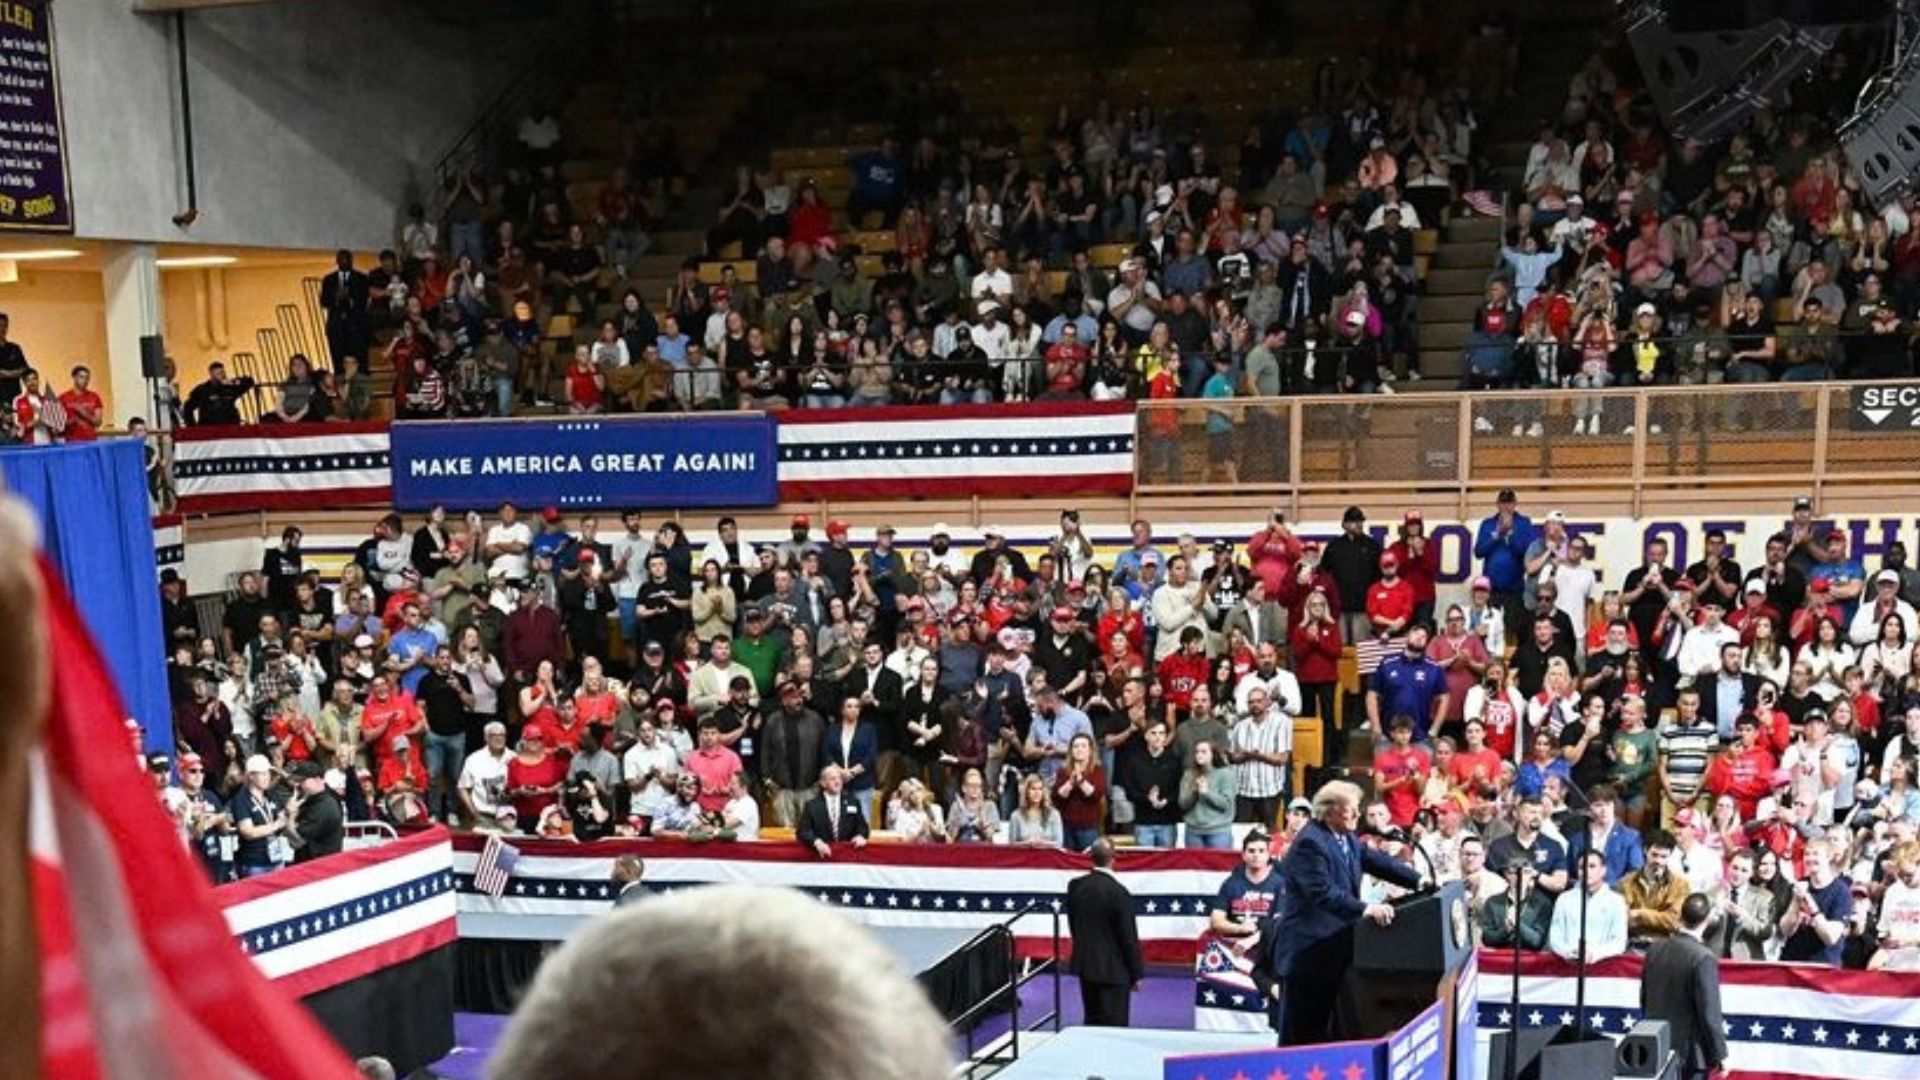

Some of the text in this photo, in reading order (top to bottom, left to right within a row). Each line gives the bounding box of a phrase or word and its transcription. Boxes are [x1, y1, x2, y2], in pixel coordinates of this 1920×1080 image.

[1863, 387, 1920, 406] SEC
[410, 453, 755, 476] MAKE AMERICA GREAT AGAIN!
